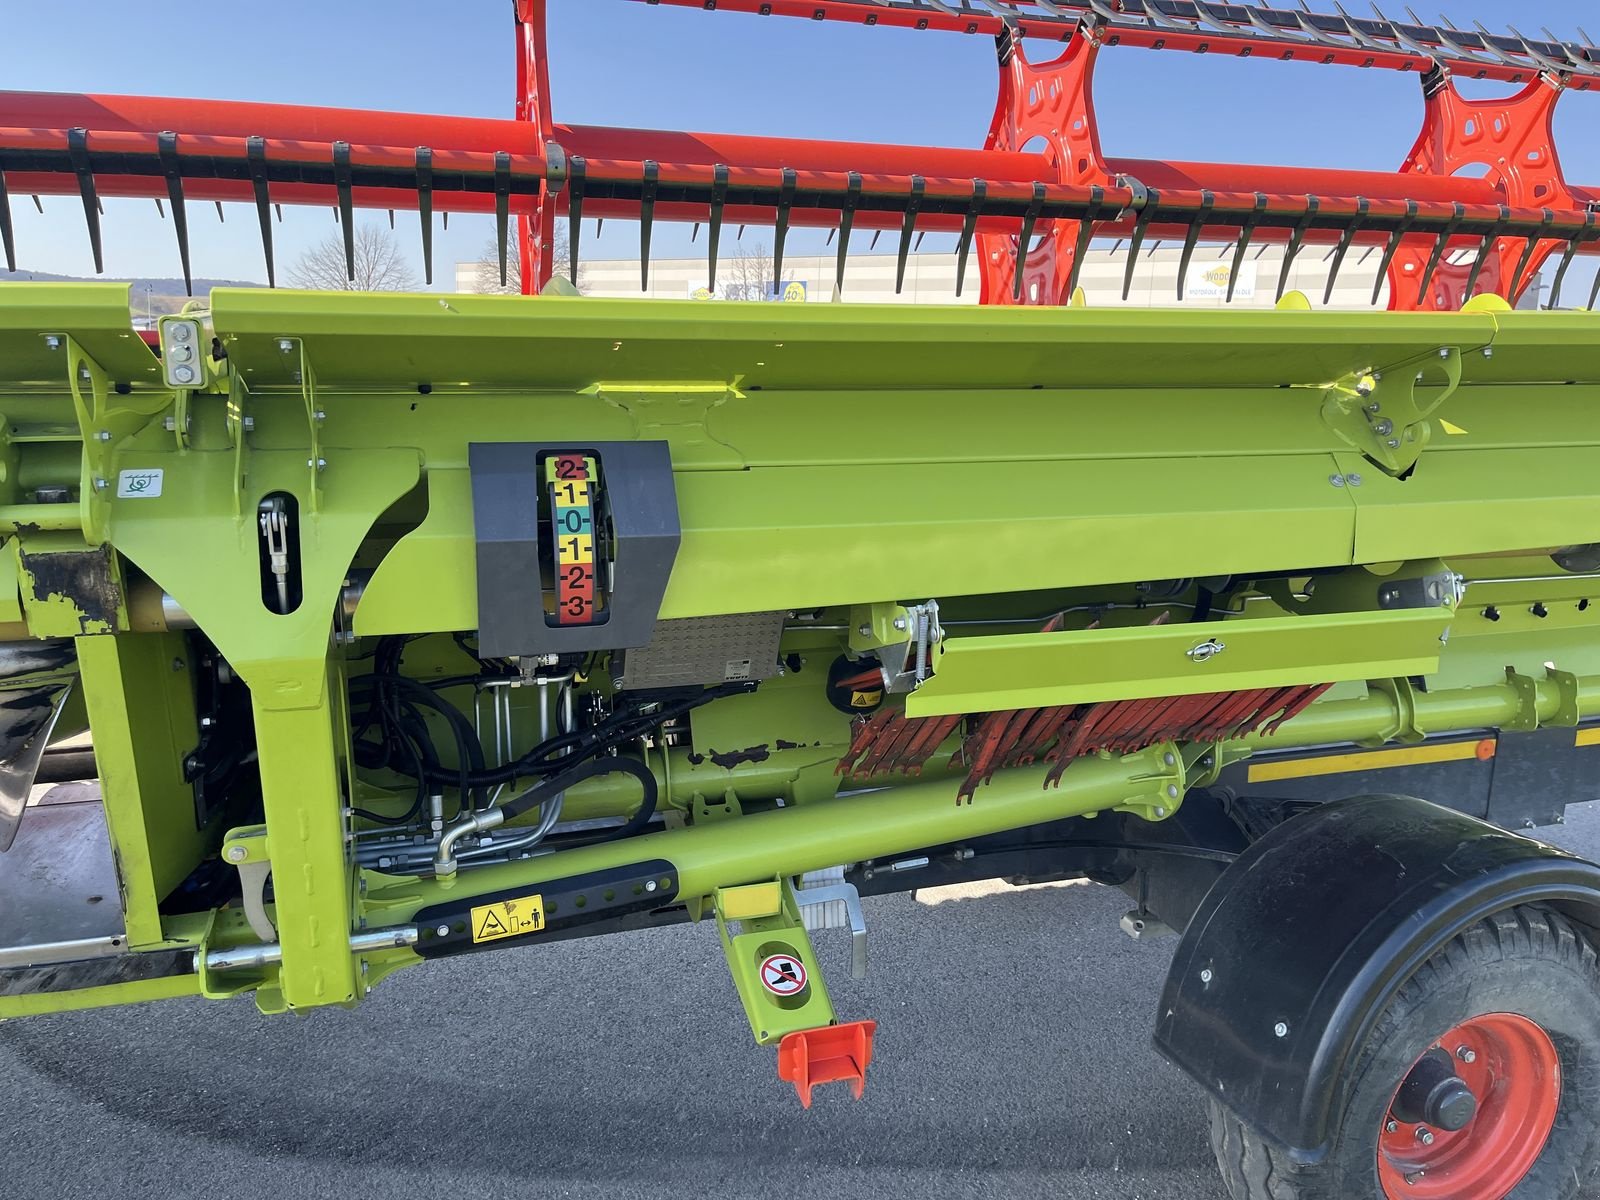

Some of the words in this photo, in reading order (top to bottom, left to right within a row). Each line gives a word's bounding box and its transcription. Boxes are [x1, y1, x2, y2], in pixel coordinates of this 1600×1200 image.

[560, 460, 577, 479] 2
[563, 483, 574, 503] 1
[565, 509, 582, 533] 0
[568, 538, 579, 560] 1
[568, 566, 585, 589] 2
[568, 596, 585, 616] 3
